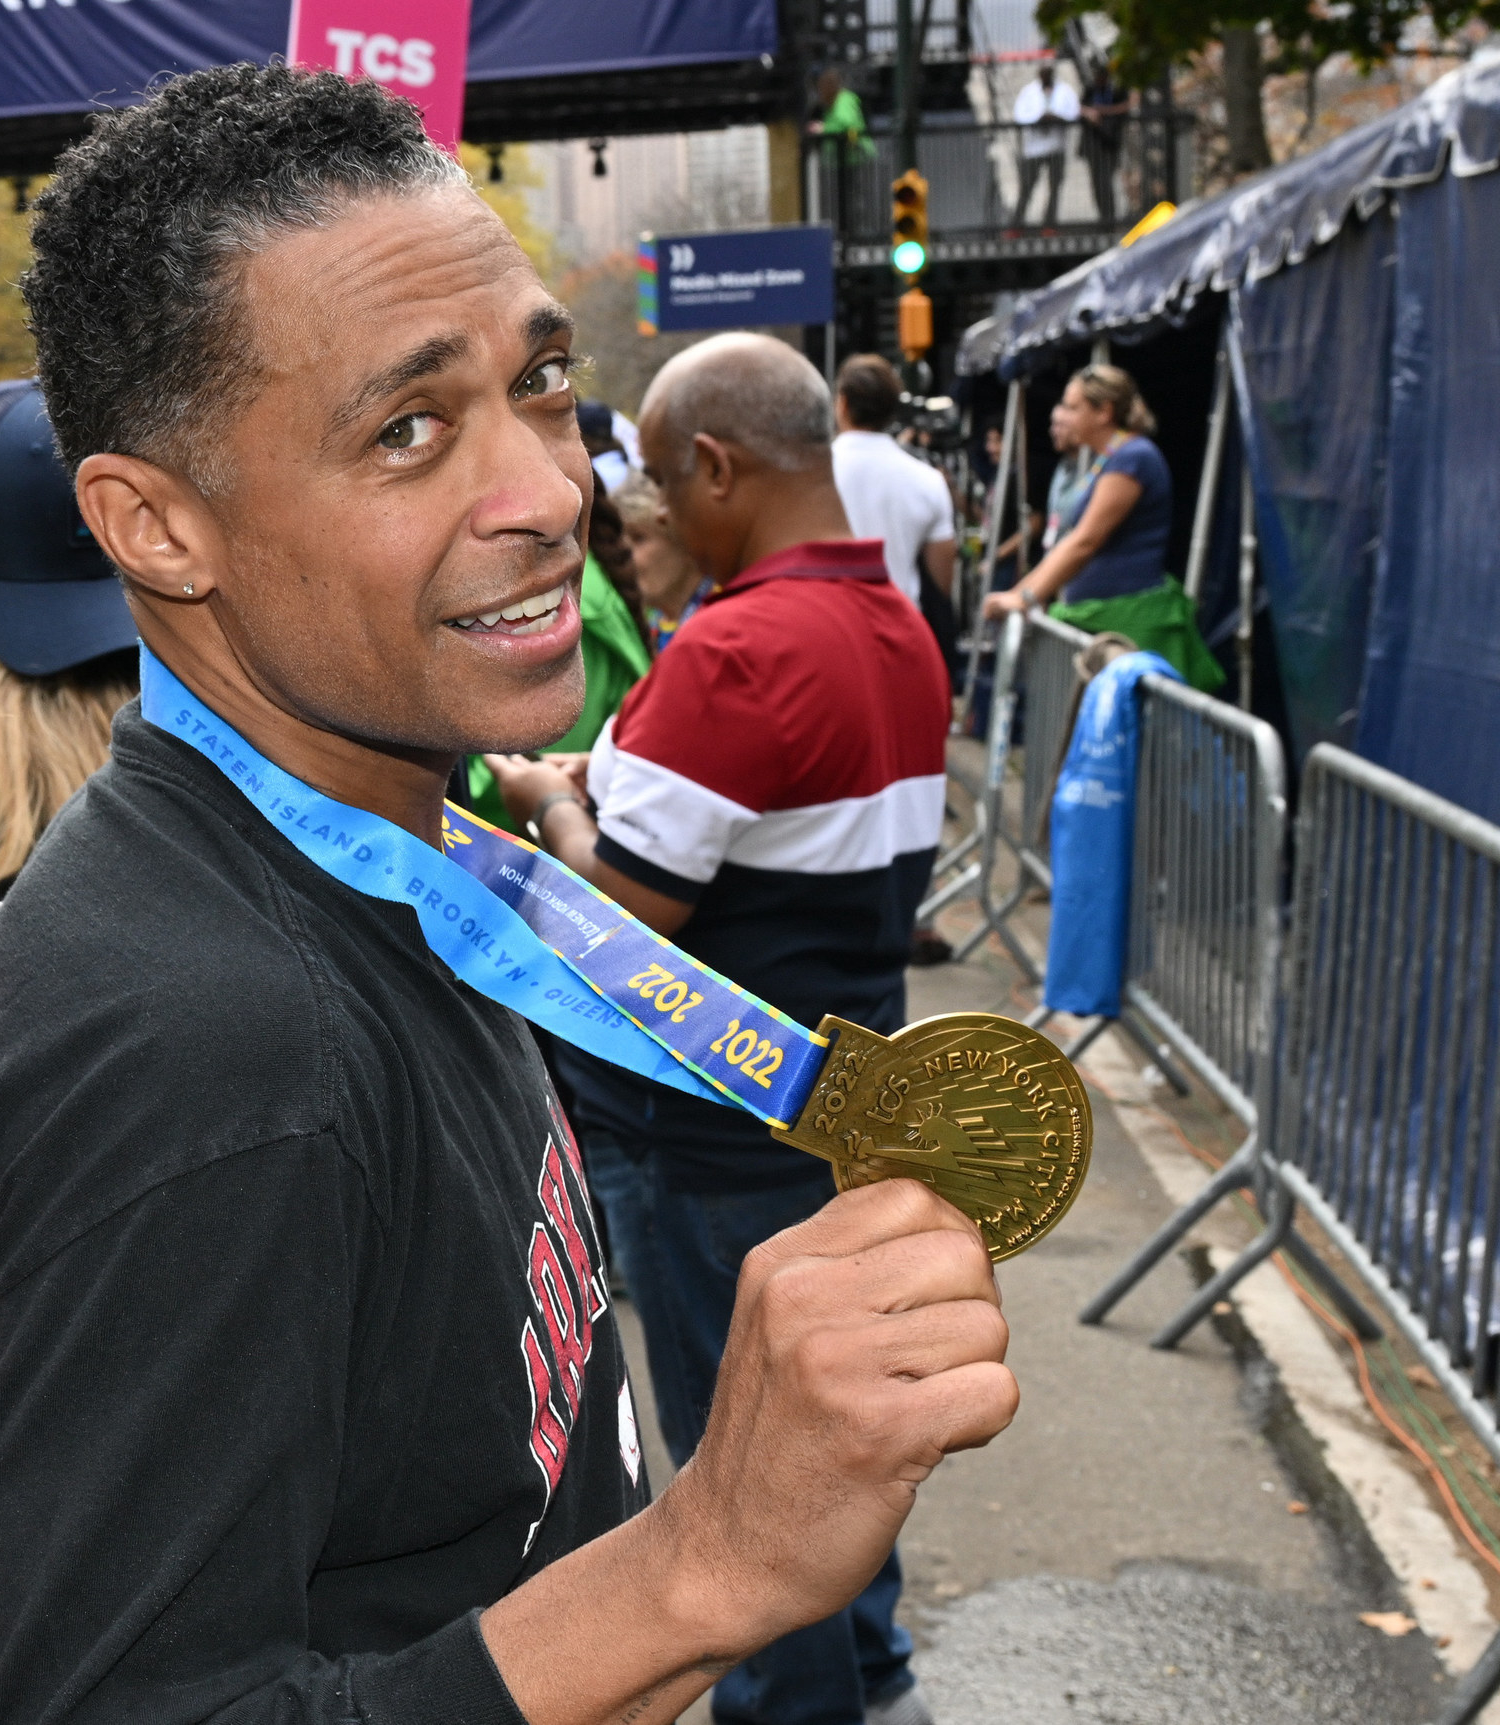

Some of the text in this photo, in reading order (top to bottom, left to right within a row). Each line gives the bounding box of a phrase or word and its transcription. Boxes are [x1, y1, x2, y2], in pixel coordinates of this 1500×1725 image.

[326, 27, 436, 88] TCS
[174, 709, 265, 794] STATEN
[269, 797, 373, 863] ISLAND
[405, 877, 527, 982] BROOKLYN
[544, 988, 626, 1030] QUEENS
[627, 962, 705, 1023] 2022
[709, 1018, 784, 1090] 2022
[814, 1051, 867, 1136] 2022
[924, 1050, 992, 1079] NEW
[1000, 1056, 1058, 1123] YORK
[1029, 1130, 1061, 1198] CITY
[1006, 1107, 1083, 1248] NEW YORK ROAD RUNNERS
